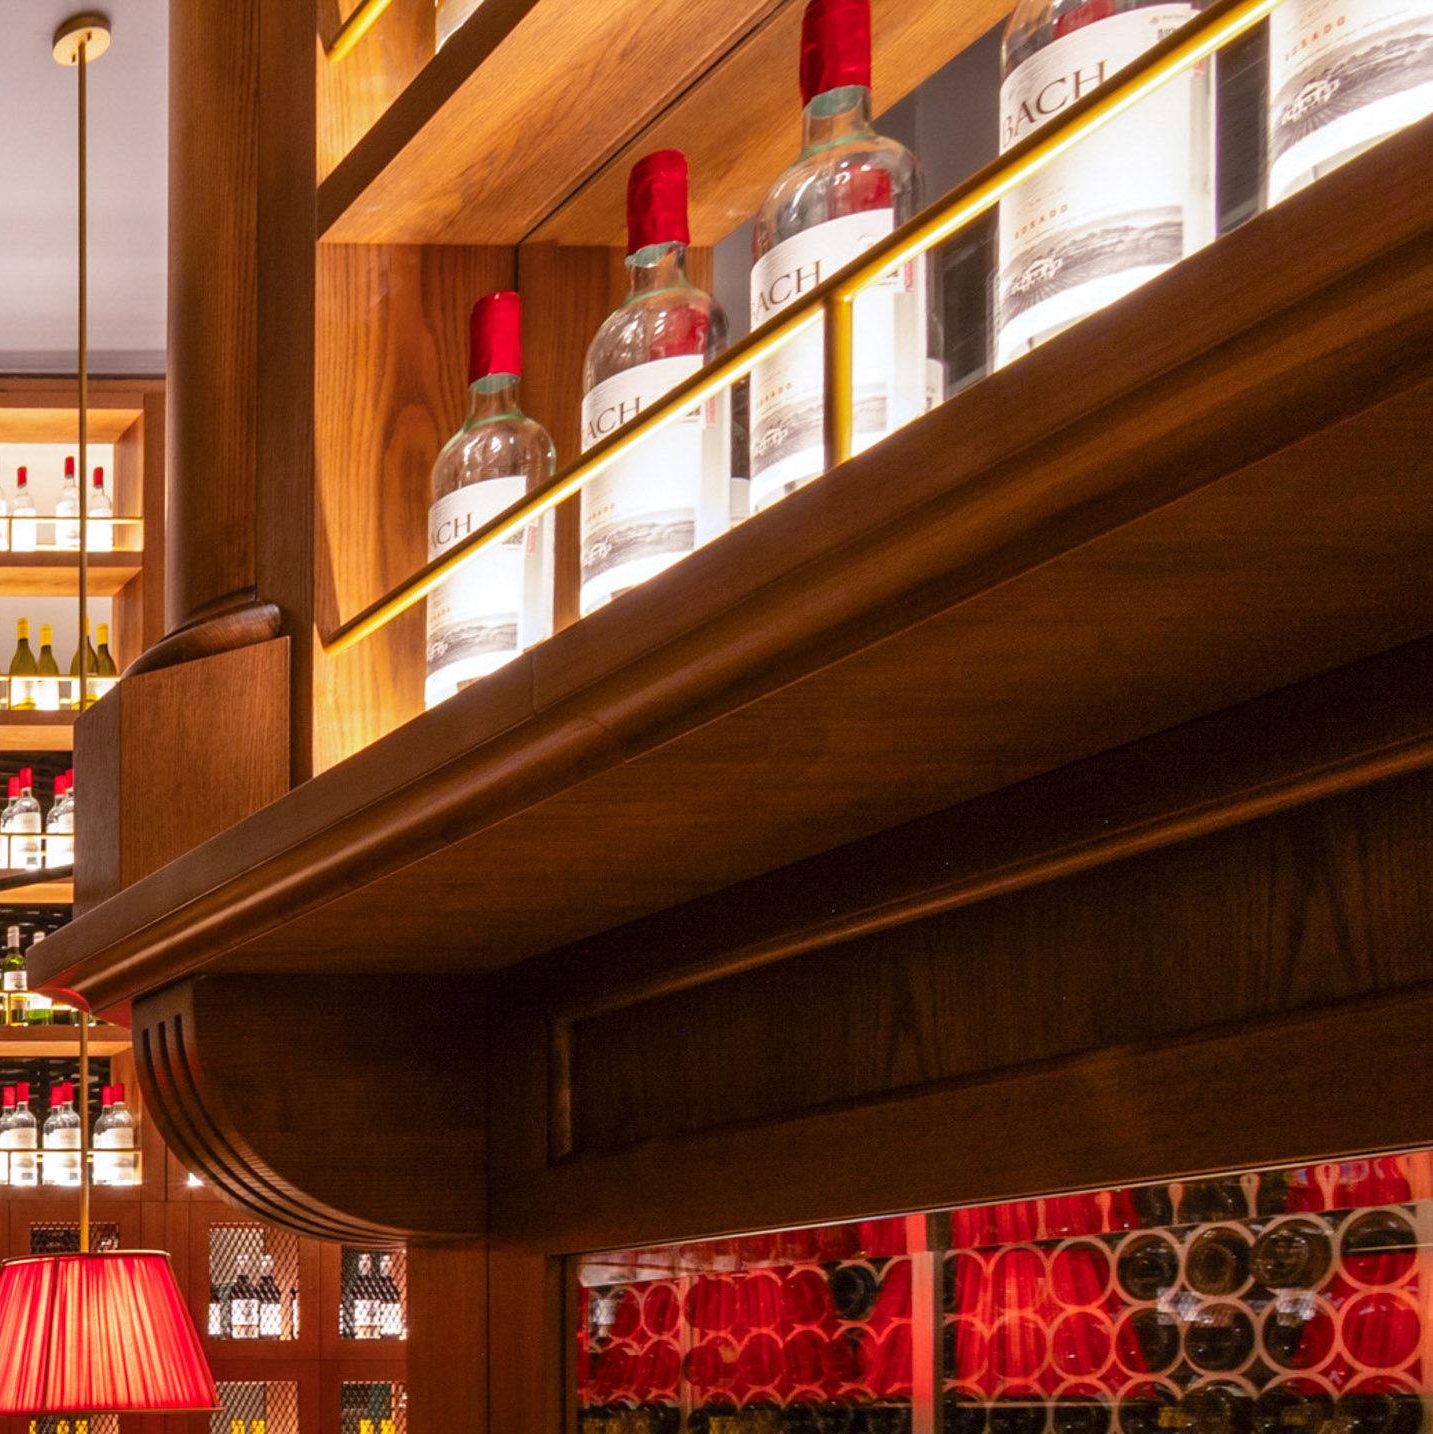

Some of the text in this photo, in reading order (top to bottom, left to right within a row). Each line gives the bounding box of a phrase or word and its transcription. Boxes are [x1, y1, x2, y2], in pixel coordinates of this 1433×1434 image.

[1003, 60, 1107, 148] BACH
[751, 260, 821, 321] ACH
[587, 396, 641, 440] ACH
